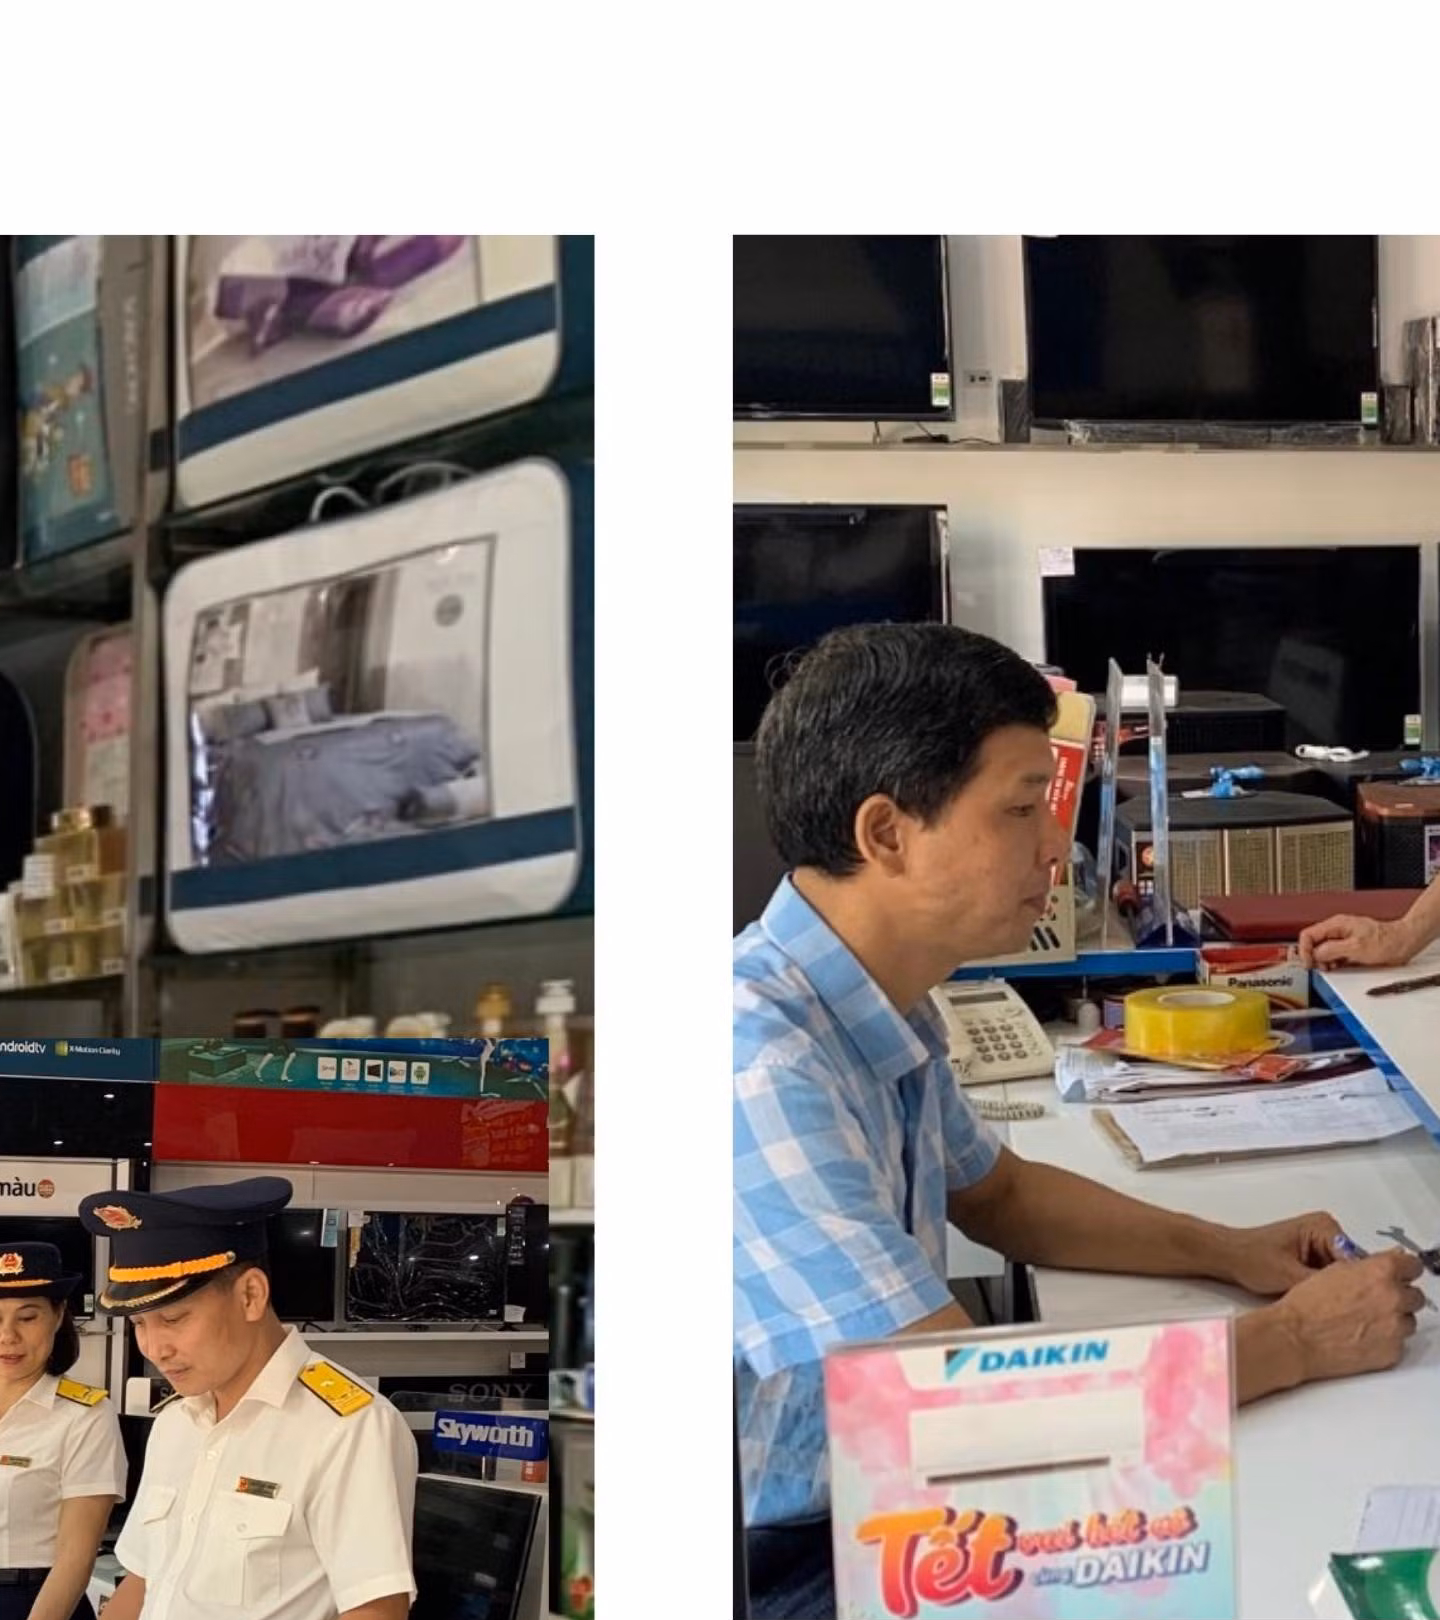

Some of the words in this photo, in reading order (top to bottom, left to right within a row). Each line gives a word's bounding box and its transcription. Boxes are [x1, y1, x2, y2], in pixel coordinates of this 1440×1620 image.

[1227, 976, 1294, 989] Panasonic
[978, 1340, 1109, 1373] DAIKIN
[448, 1382, 531, 1403] SONY
[436, 1417, 534, 1447] Skyworth
[856, 1506, 1024, 1619] Tết
[1073, 1540, 1211, 1588] DAIKIN
